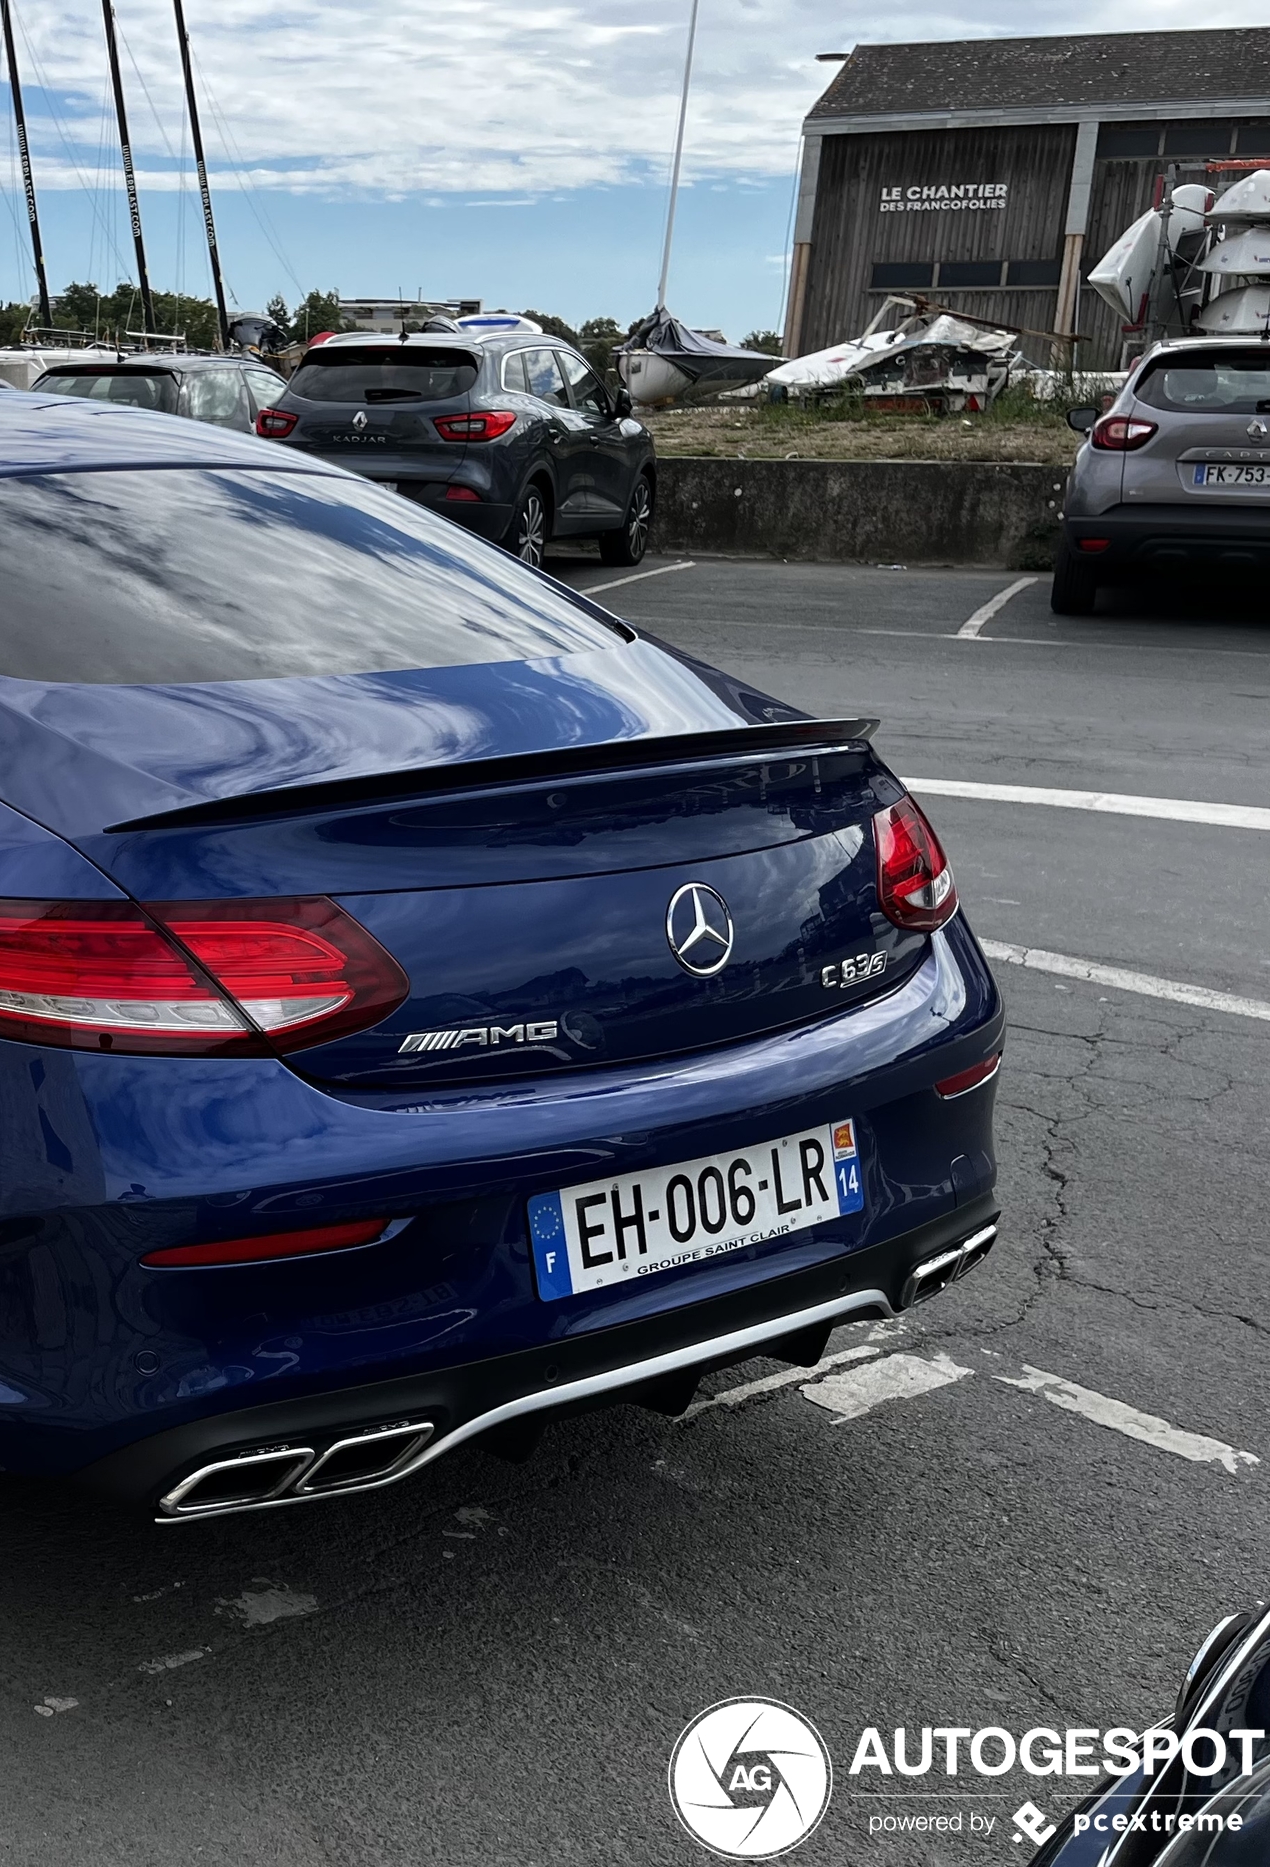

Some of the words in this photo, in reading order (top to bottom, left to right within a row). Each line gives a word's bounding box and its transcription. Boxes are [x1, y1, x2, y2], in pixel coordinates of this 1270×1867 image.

[881, 186, 902, 200] LE
[906, 183, 1008, 200] CHANTIER
[880, 201, 904, 212] DES
[906, 198, 1006, 211] FRANCOFOLIES
[332, 435, 387, 444] KADJAR
[821, 965, 837, 988] C
[838, 1164, 859, 1197] 14
[574, 1137, 830, 1270] EH-006-LR
[636, 1250, 701, 1276] GROUPE
[705, 1237, 747, 1257] SAINT
[750, 1223, 791, 1243] CLAIR
[545, 1251, 556, 1274] F
